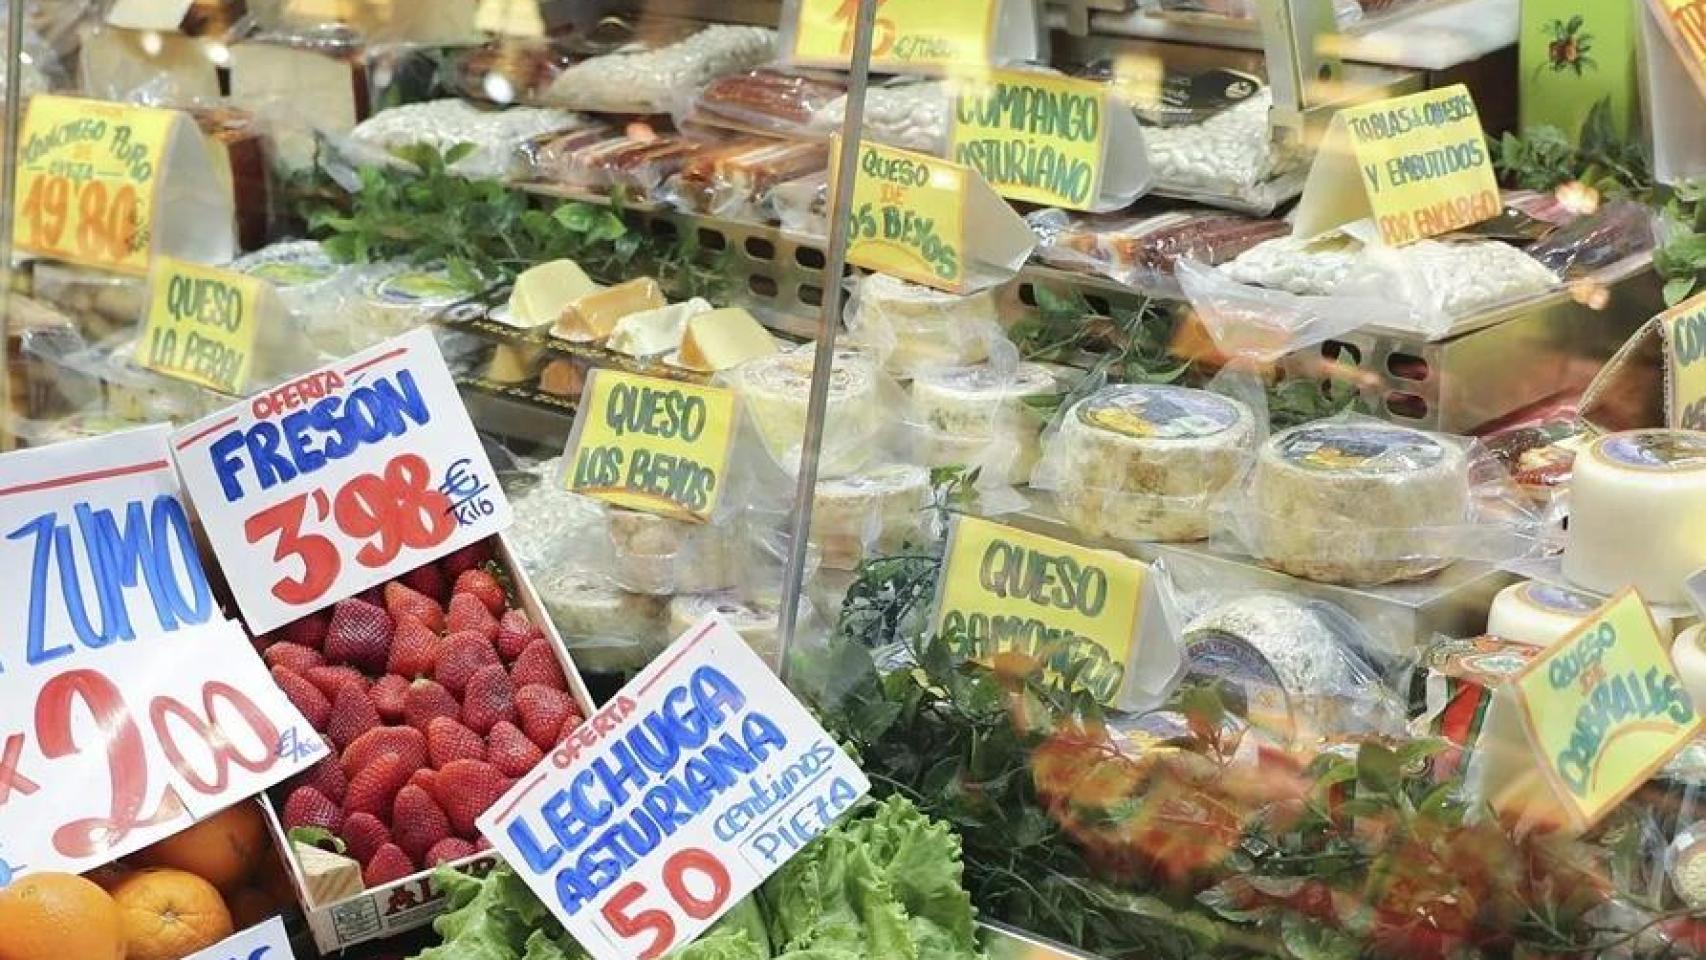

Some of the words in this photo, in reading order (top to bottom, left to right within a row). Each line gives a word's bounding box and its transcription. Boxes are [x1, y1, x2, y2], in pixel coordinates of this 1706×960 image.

[861, 148, 930, 188] QUESO
[1364, 164, 1380, 193] Y
[1386, 139, 1484, 186] EMBUTIDOS
[847, 202, 877, 248] OS
[1379, 211, 1414, 246] POR
[1414, 189, 1497, 238] ENCARGO
[168, 272, 243, 333] QUESO
[149, 326, 178, 368] LA
[252, 371, 345, 419] OFERTA
[606, 382, 706, 443] QUESO
[208, 368, 431, 502] FRESÓN
[573, 446, 624, 488] LOS
[7, 494, 212, 666] ZUMO
[979, 538, 1108, 618] QUESO
[1549, 621, 1617, 689] QUESO
[552, 694, 639, 771] OFERTA
[506, 665, 747, 876] LECHUGA
[554, 711, 788, 916] ASTURIANA
[600, 847, 732, 960] 50
